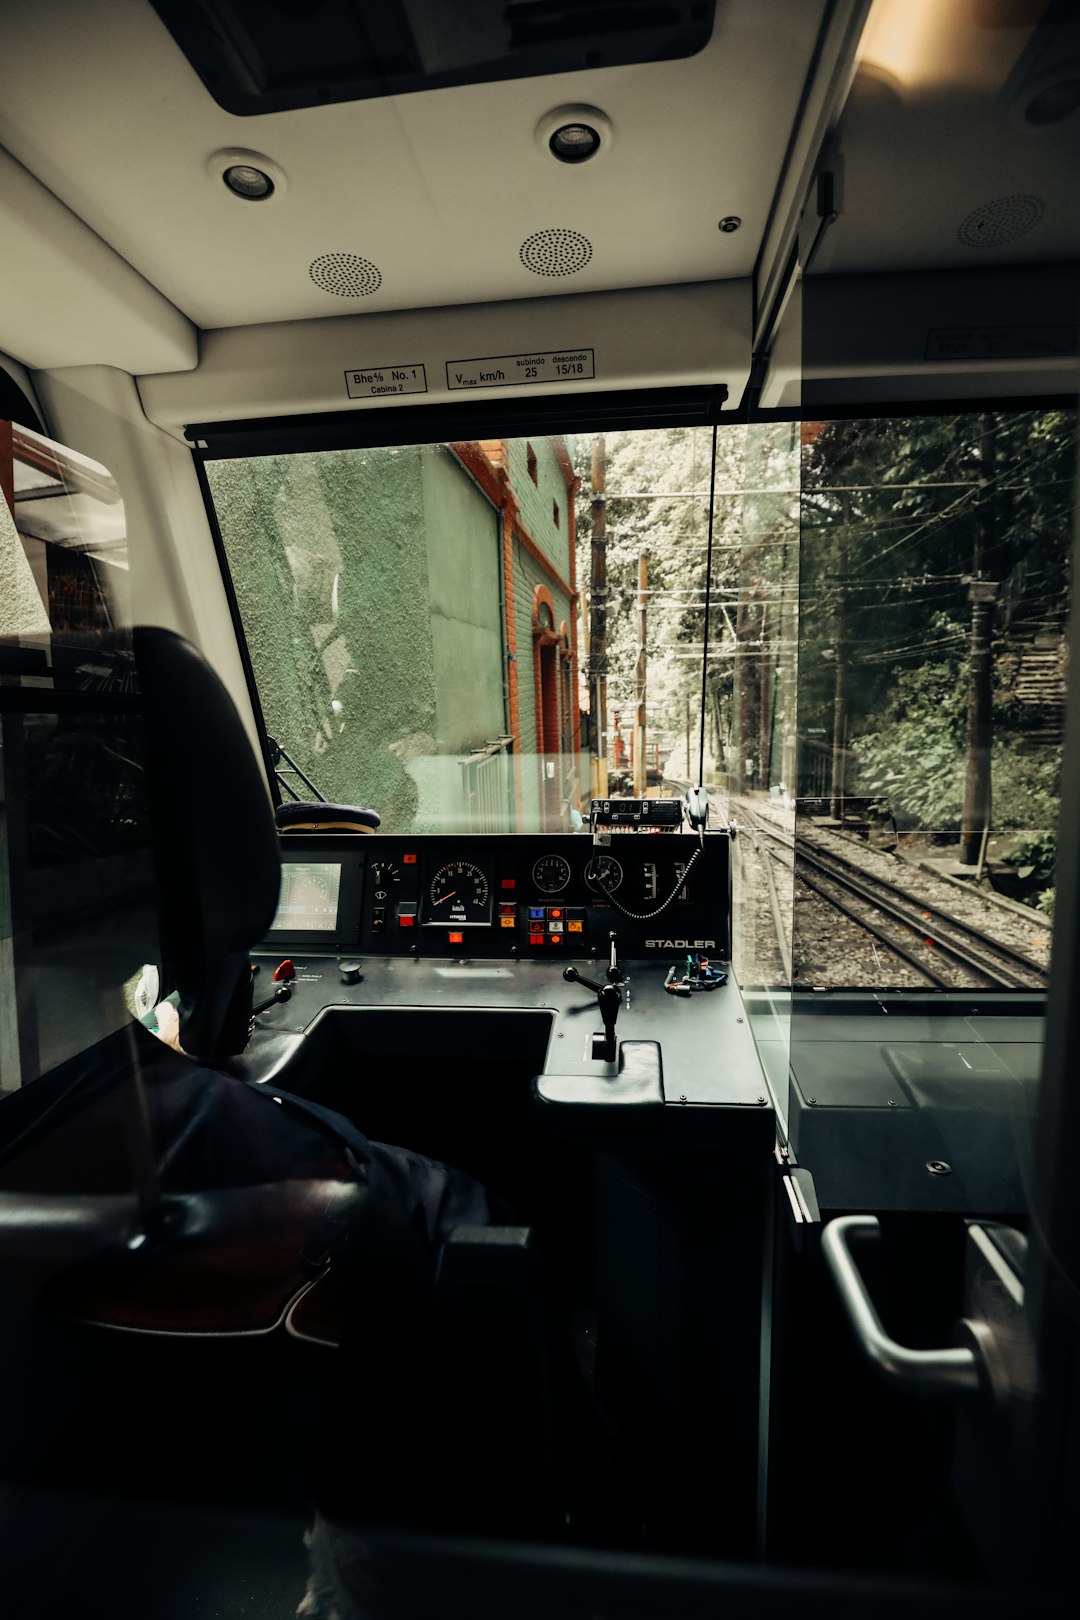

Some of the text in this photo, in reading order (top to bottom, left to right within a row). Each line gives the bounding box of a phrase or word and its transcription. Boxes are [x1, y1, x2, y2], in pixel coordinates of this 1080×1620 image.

[517, 354, 587, 366] subindo descendo
[392, 371, 409, 380] No.
[411, 370, 417, 379] 1
[480, 370, 505, 382] km/h
[525, 367, 538, 378] 25
[556, 363, 583, 376] 15/18
[371, 384, 404, 394] Cabina 2
[645, 940, 716, 949] STADLER
